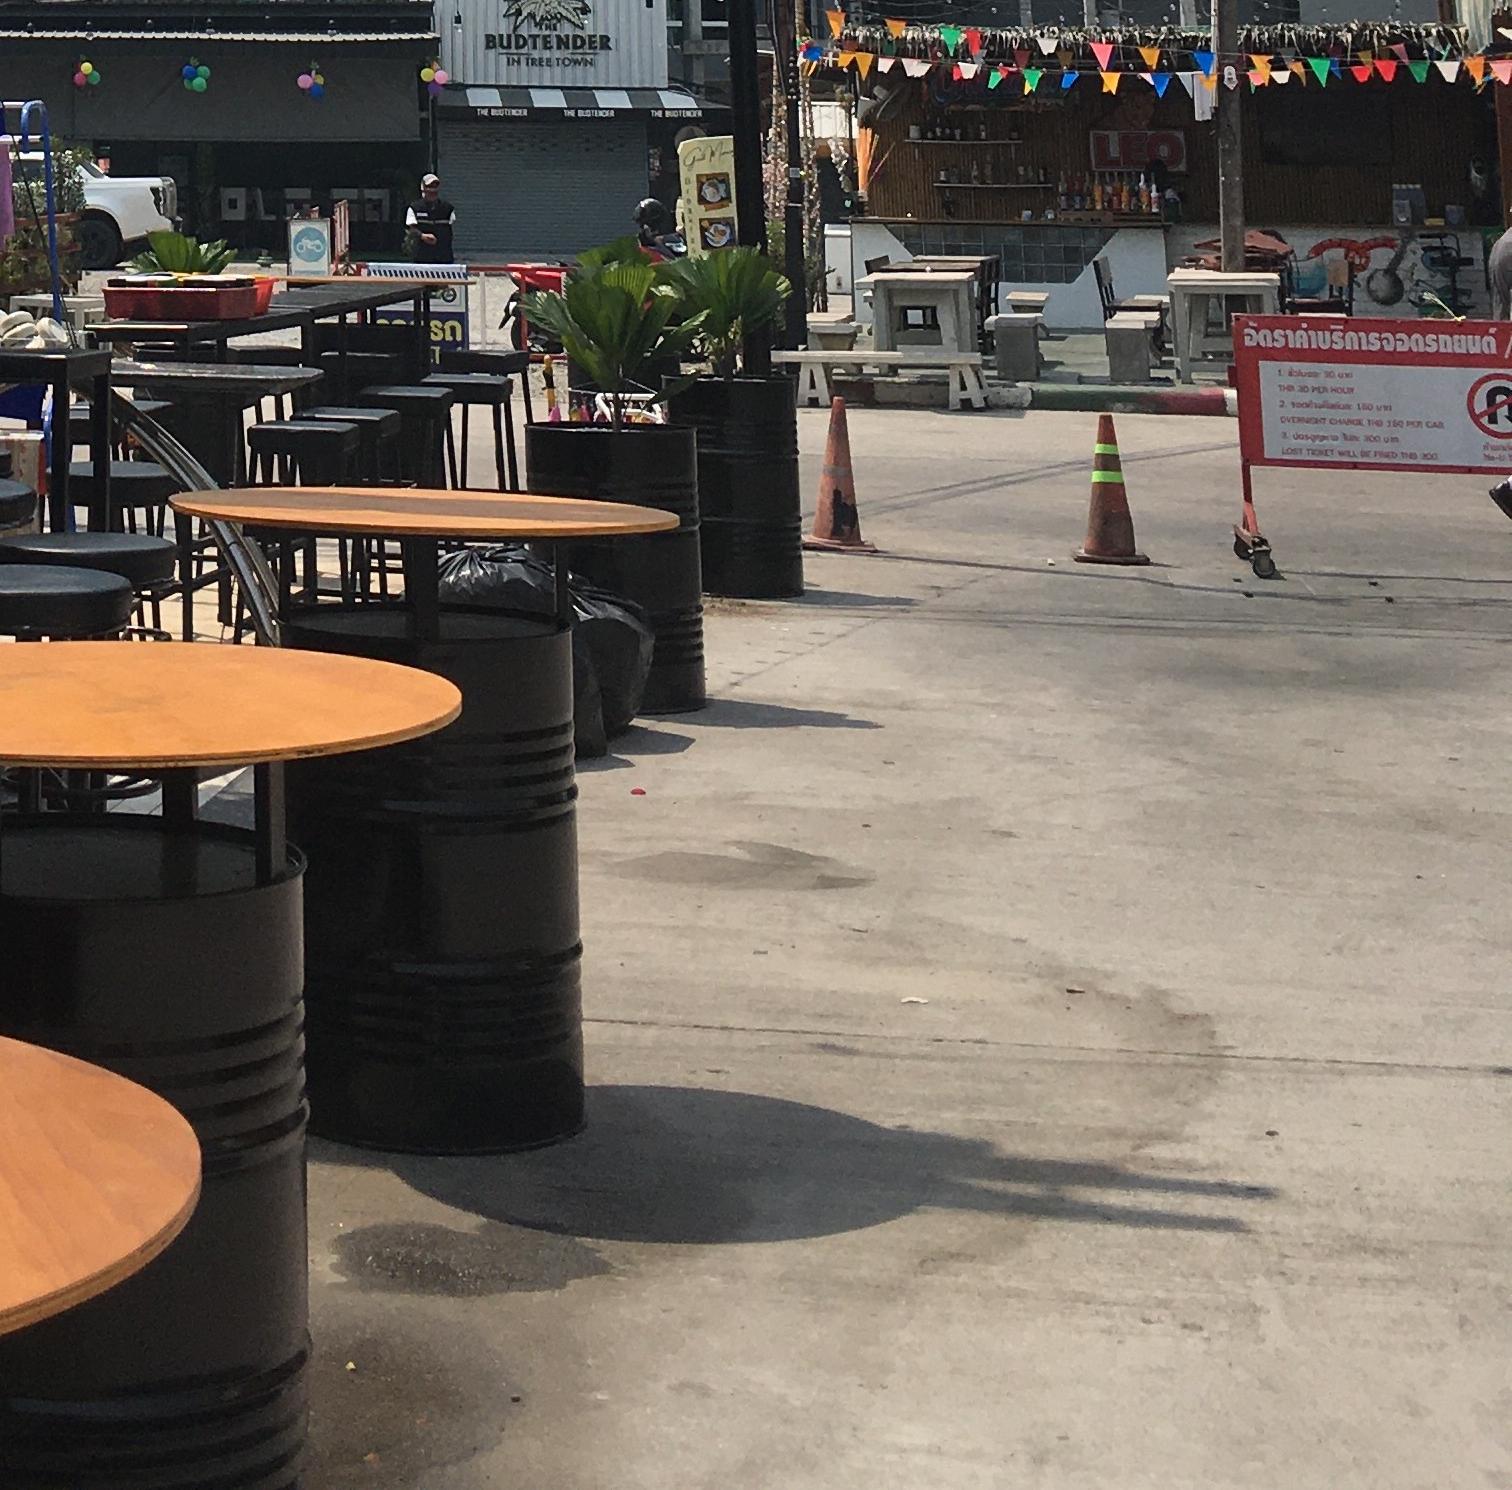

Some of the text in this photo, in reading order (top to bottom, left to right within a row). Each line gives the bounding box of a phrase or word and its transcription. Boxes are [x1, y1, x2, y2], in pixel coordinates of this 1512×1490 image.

[484, 33, 613, 51] BUDTENDER
[506, 56, 595, 68] IN TREE TOWN
[477, 108, 528, 117] THE BUDTENDER
[563, 109, 615, 118] THE BUDTENDER
[651, 109, 703, 118] THE BUDTENDER
[1095, 132, 1185, 170] LEO
[1243, 322, 1498, 355] อัตราค่าบริการจอดรถยนต์
[1278, 385, 1295, 393] THB
[1312, 386, 1329, 394] PER
[1331, 386, 1355, 394] HOUR
[1280, 416, 1327, 425] OVERNIGHT
[1329, 418, 1364, 427] CHARGE
[1406, 420, 1424, 429] PER
[1281, 447, 1303, 456] LOST
[1306, 448, 1335, 457] TICKET
[1338, 450, 1358, 458] WILL
[1360, 450, 1372, 458] BE
